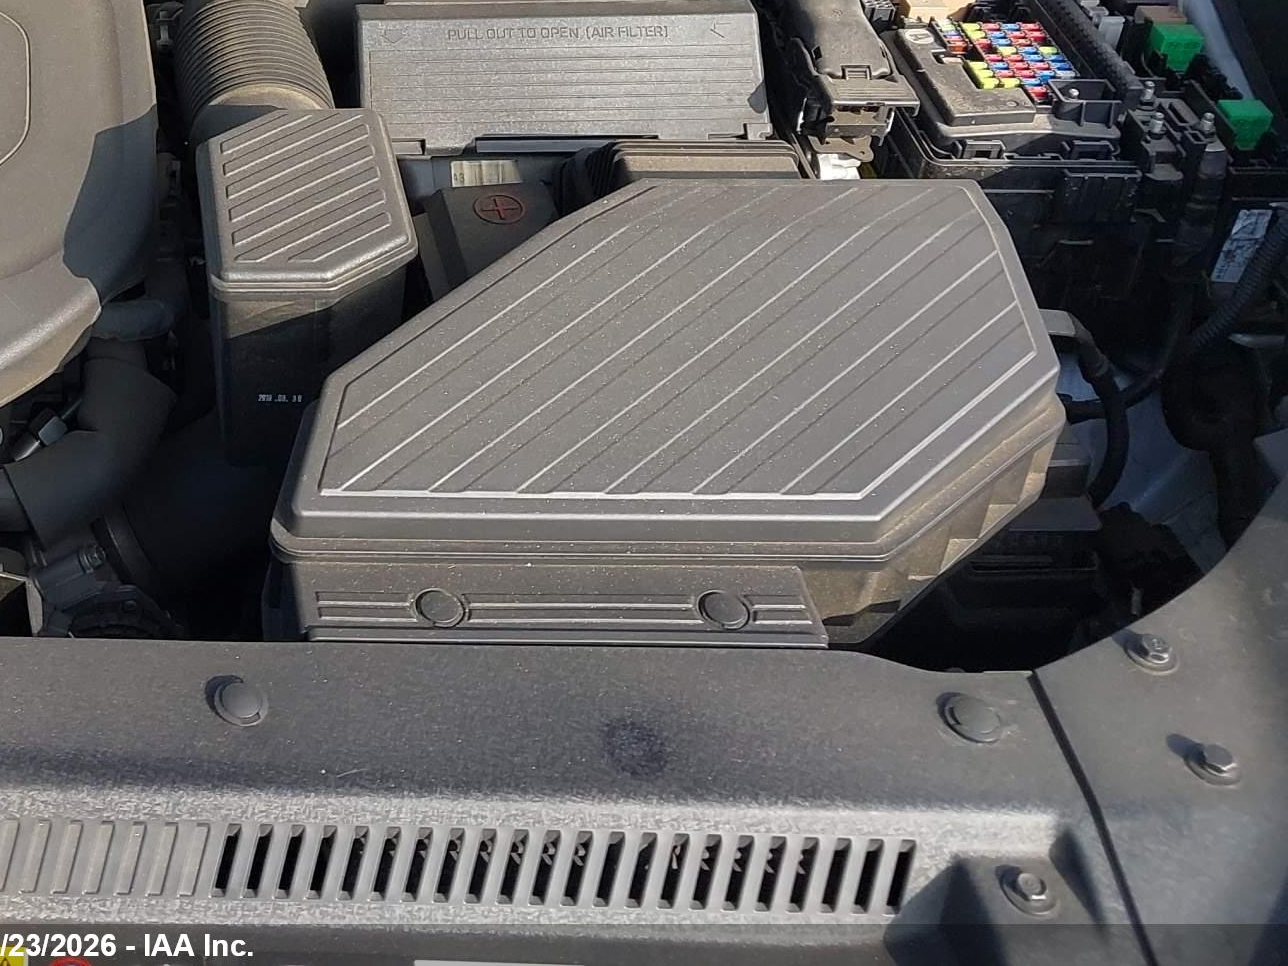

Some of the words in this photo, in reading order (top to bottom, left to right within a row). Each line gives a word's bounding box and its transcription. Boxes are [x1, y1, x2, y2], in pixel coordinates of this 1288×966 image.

[447, 28, 485, 41] PULL
[486, 27, 513, 39] OUT
[519, 27, 537, 39] TO
[540, 26, 580, 39] OPEN
[585, 26, 615, 40] (AIR
[617, 25, 669, 38] FILTER)
